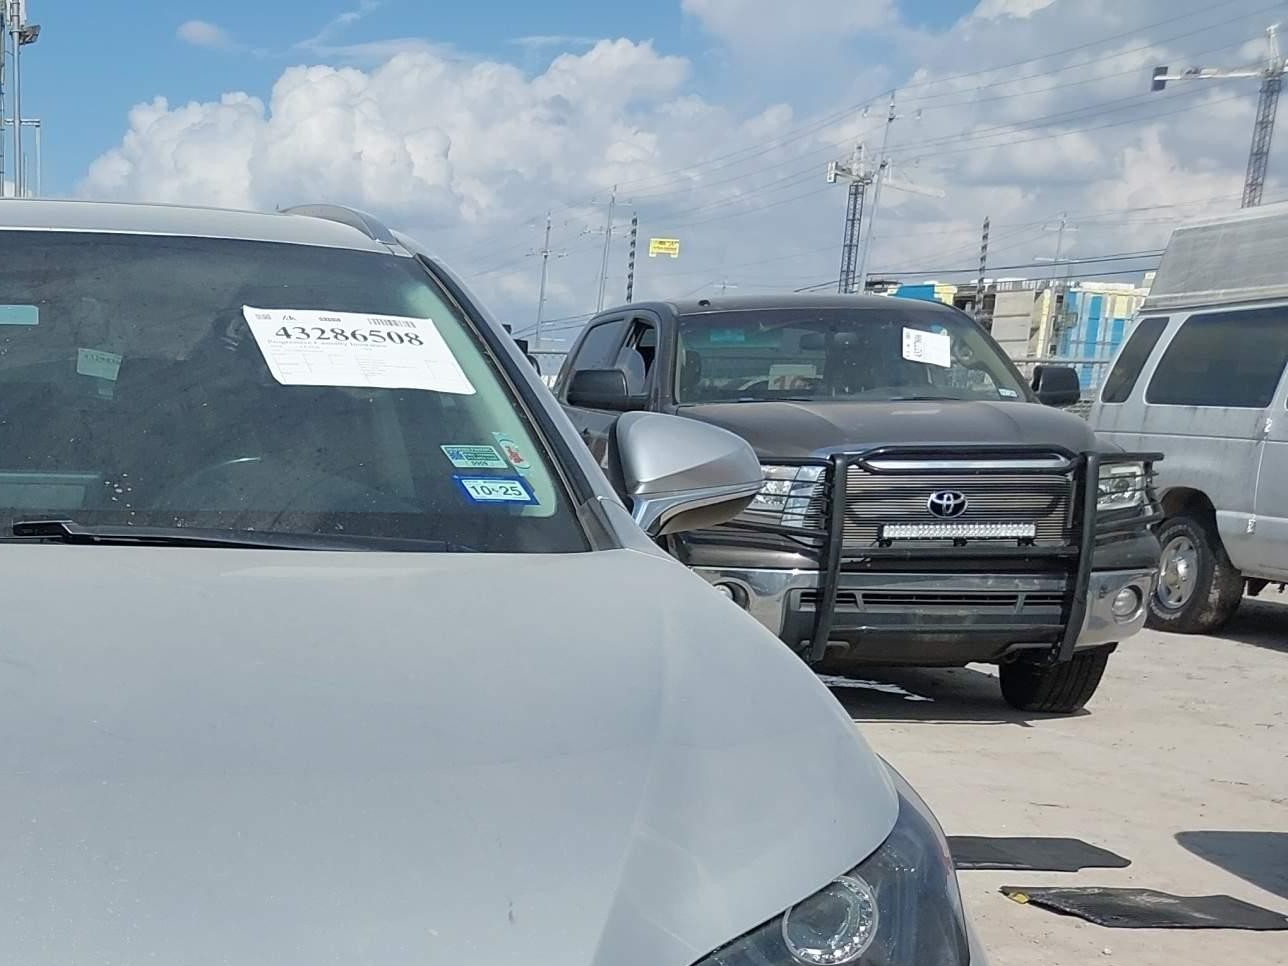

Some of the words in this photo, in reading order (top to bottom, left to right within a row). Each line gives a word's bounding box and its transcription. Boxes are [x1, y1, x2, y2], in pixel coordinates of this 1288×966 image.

[275, 326, 424, 346] 43286508
[470, 485, 492, 496] 10
[499, 486, 522, 497] 25
